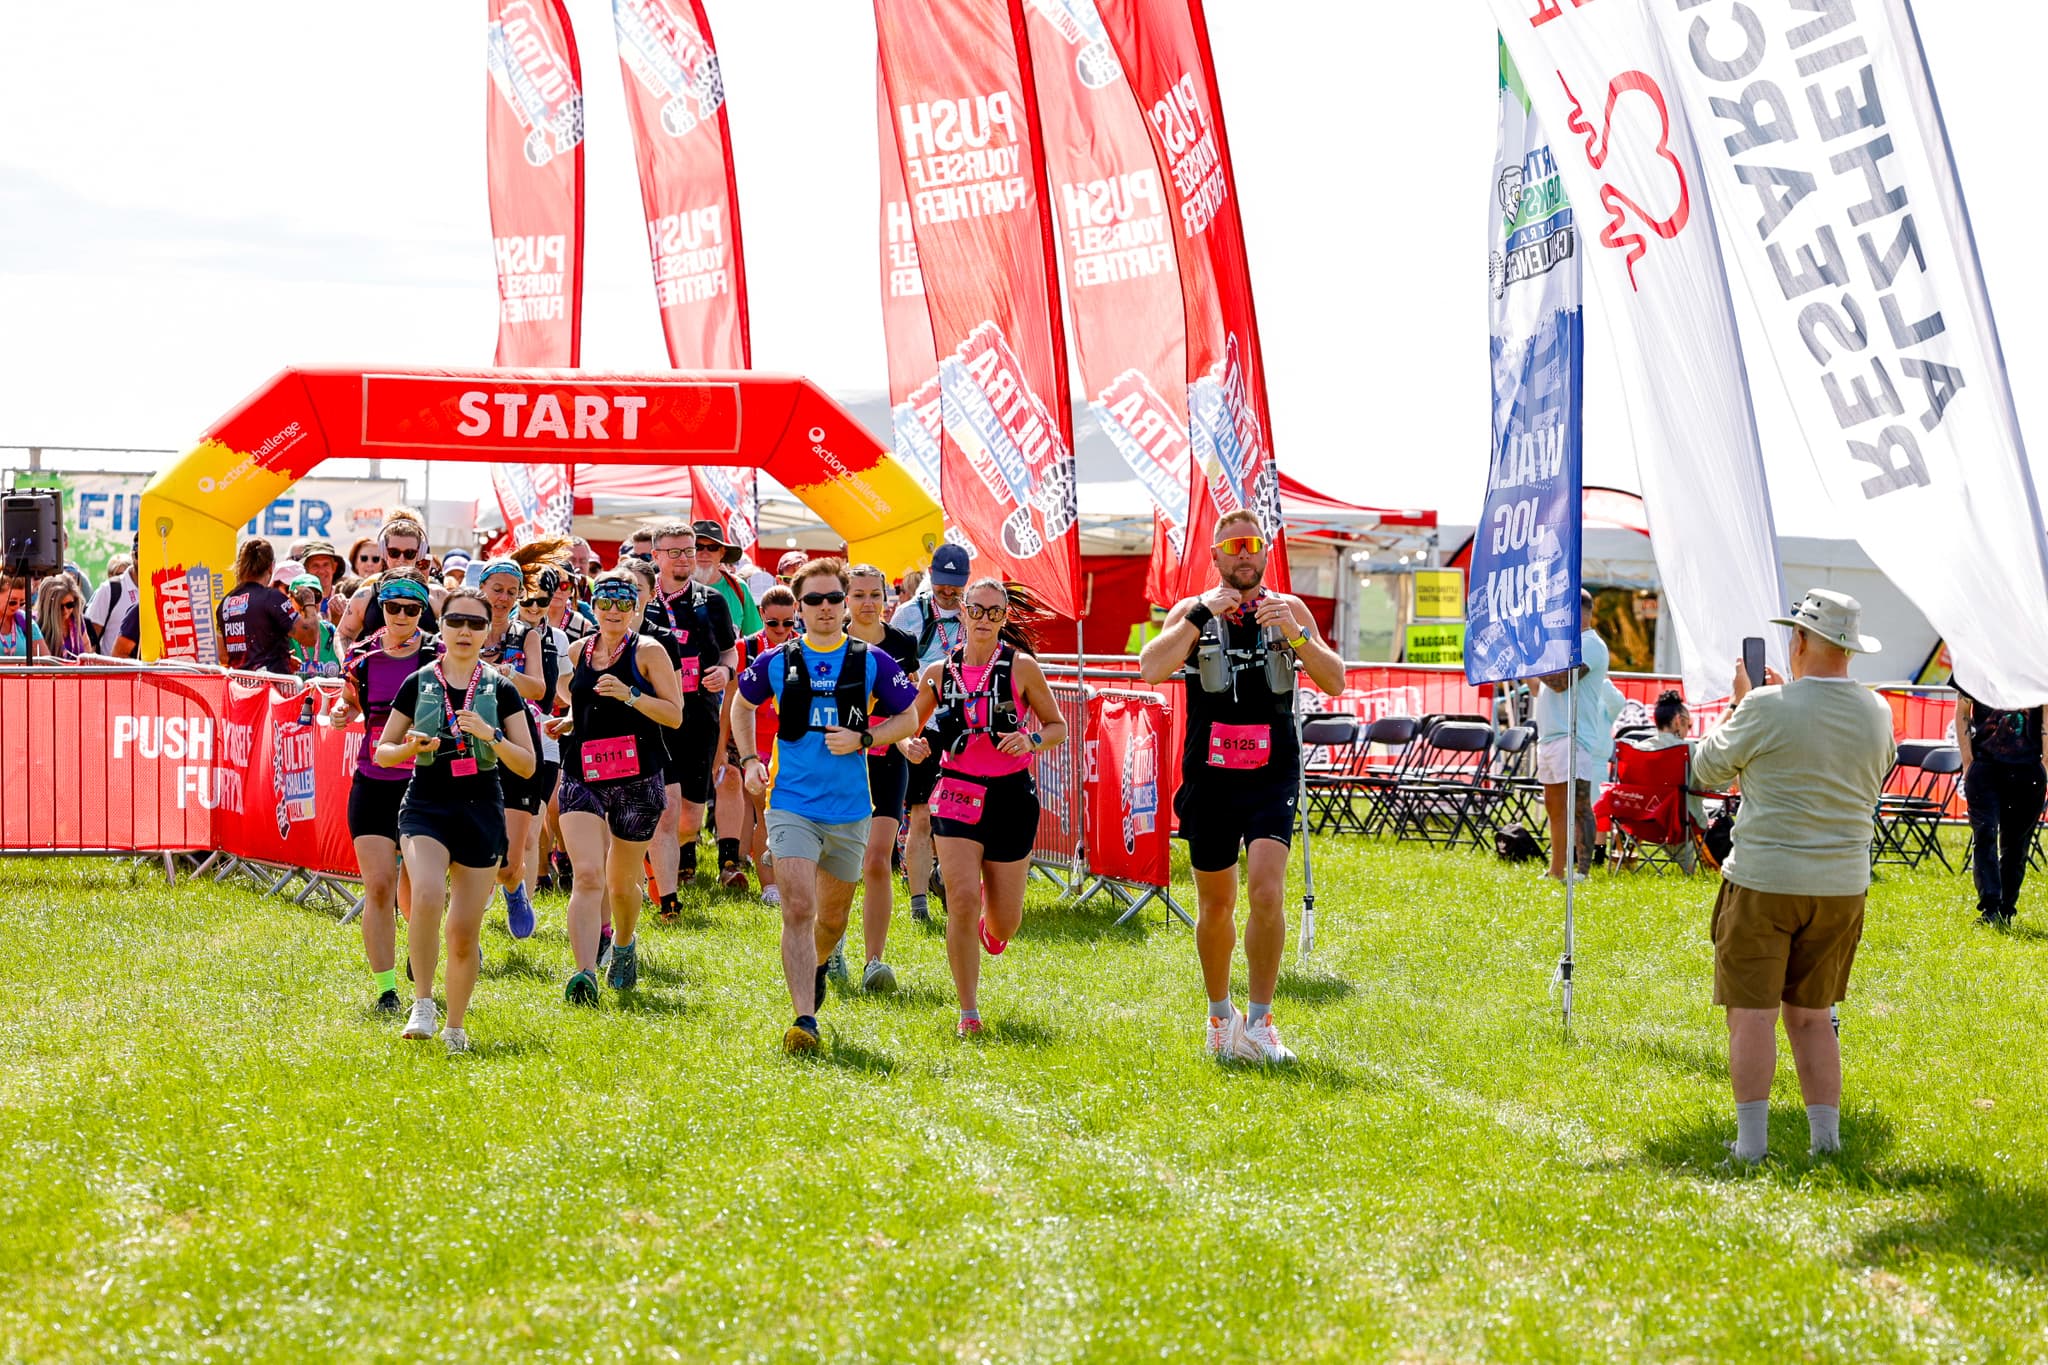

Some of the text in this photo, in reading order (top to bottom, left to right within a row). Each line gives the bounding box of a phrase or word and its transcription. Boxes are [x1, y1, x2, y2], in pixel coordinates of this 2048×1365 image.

[457, 390, 647, 440] START
[160, 574, 198, 663] LTRA
[190, 573, 217, 664] HALLENGE
[225, 621, 245, 637] PUSH
[1407, 651, 1464, 663] COLLECTION
[1413, 634, 1458, 647] BAGGAGE
[113, 715, 215, 760] PUSH
[283, 732, 314, 771] ULTR
[341, 731, 366, 777] PUS
[1223, 738, 1256, 751] 6125
[594, 751, 624, 764] 6111
[176, 765, 244, 816] FURT
[285, 769, 314, 797] CHALLE
[941, 789, 970, 806] 6124
